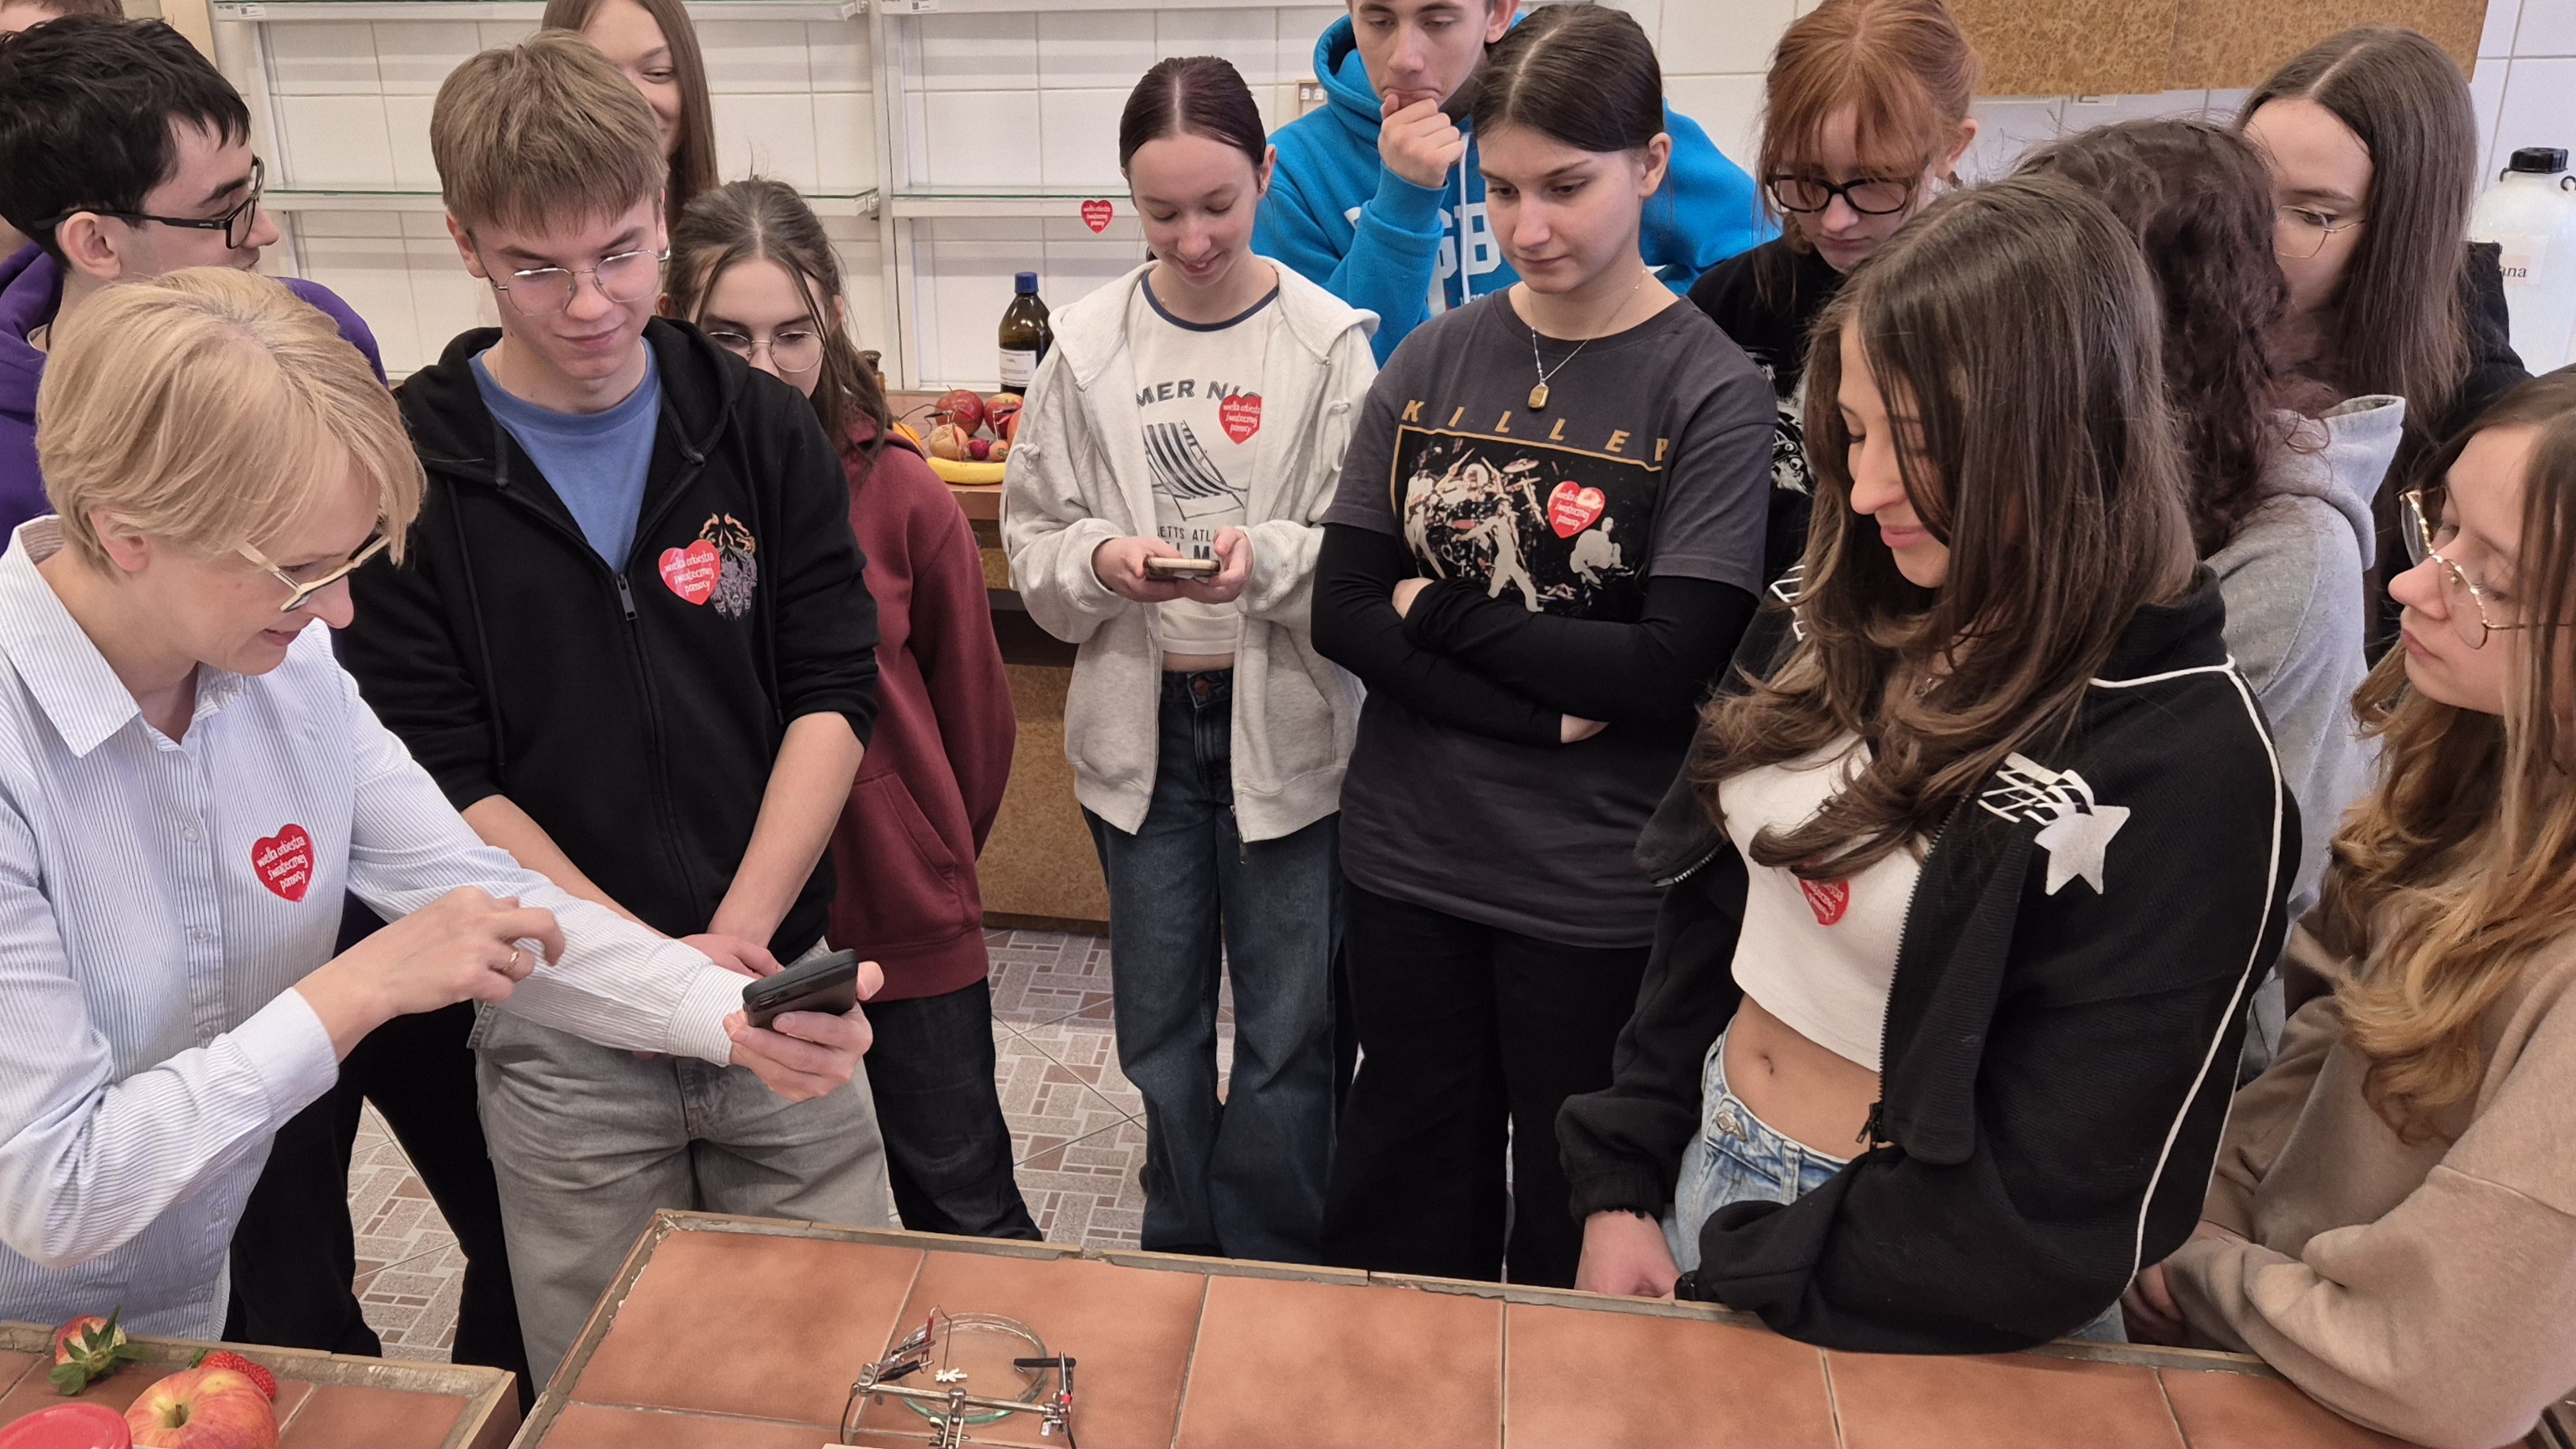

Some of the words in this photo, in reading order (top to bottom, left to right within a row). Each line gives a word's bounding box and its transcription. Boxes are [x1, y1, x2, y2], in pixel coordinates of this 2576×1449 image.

[1158, 525, 1185, 540] ETTS
[1192, 529, 1216, 542] ATL
[664, 556, 686, 572] wielka
[686, 550, 715, 566] orkiestra
[684, 580, 710, 596] pomocy
[256, 846, 279, 868] wielka
[277, 835, 306, 856] orkiestra
[279, 870, 306, 893] pomocy
